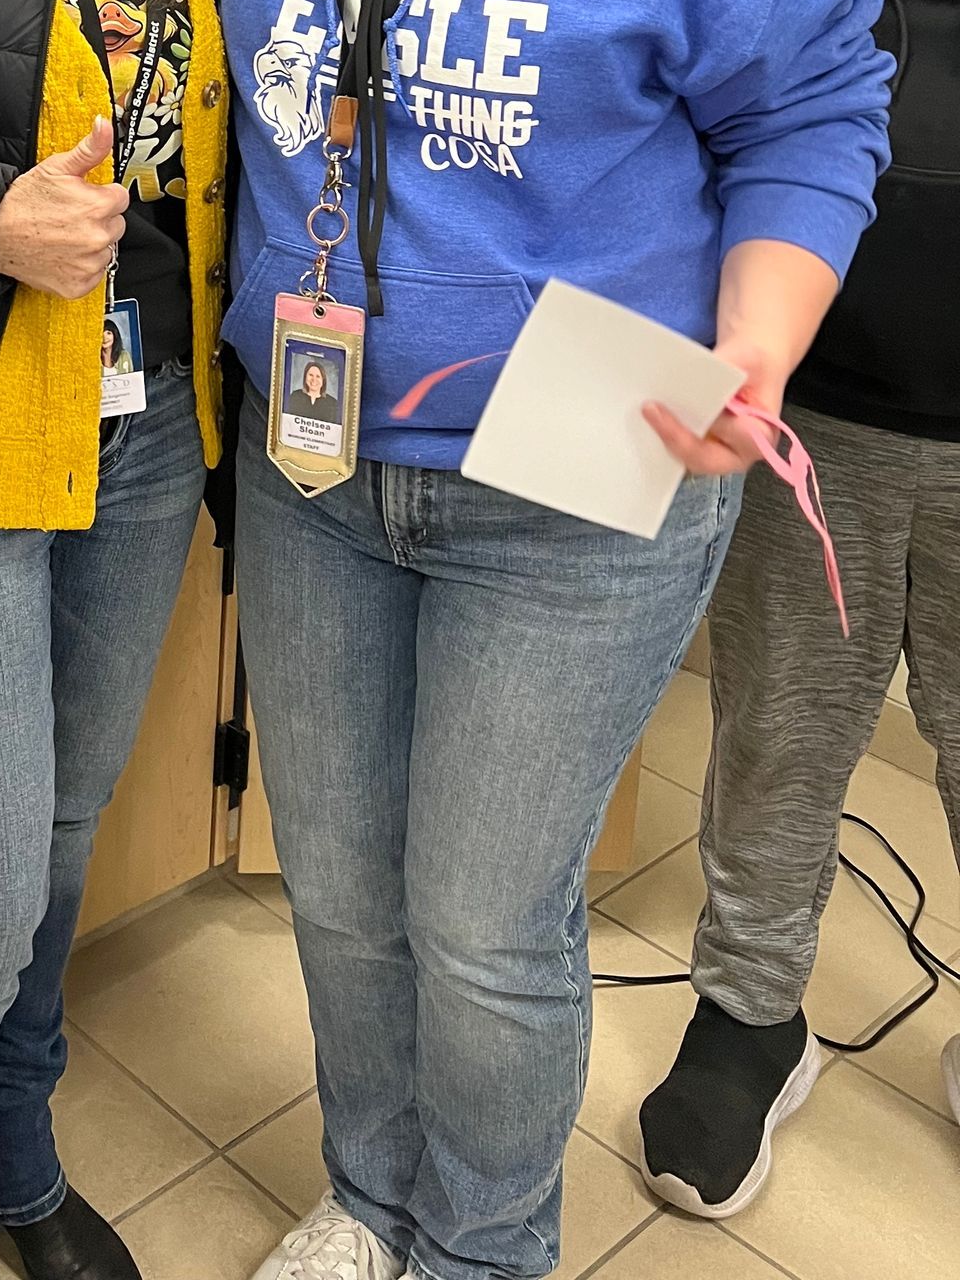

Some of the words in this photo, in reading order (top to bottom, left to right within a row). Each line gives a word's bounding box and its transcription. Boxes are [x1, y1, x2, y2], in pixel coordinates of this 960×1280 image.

[142, 21, 161, 66] District
[132, 67, 153, 107] School
[410, 85, 535, 148] THING
[421, 132, 525, 180] COSA
[294, 417, 331, 431] Chelsea
[299, 425, 325, 438] Sloan
